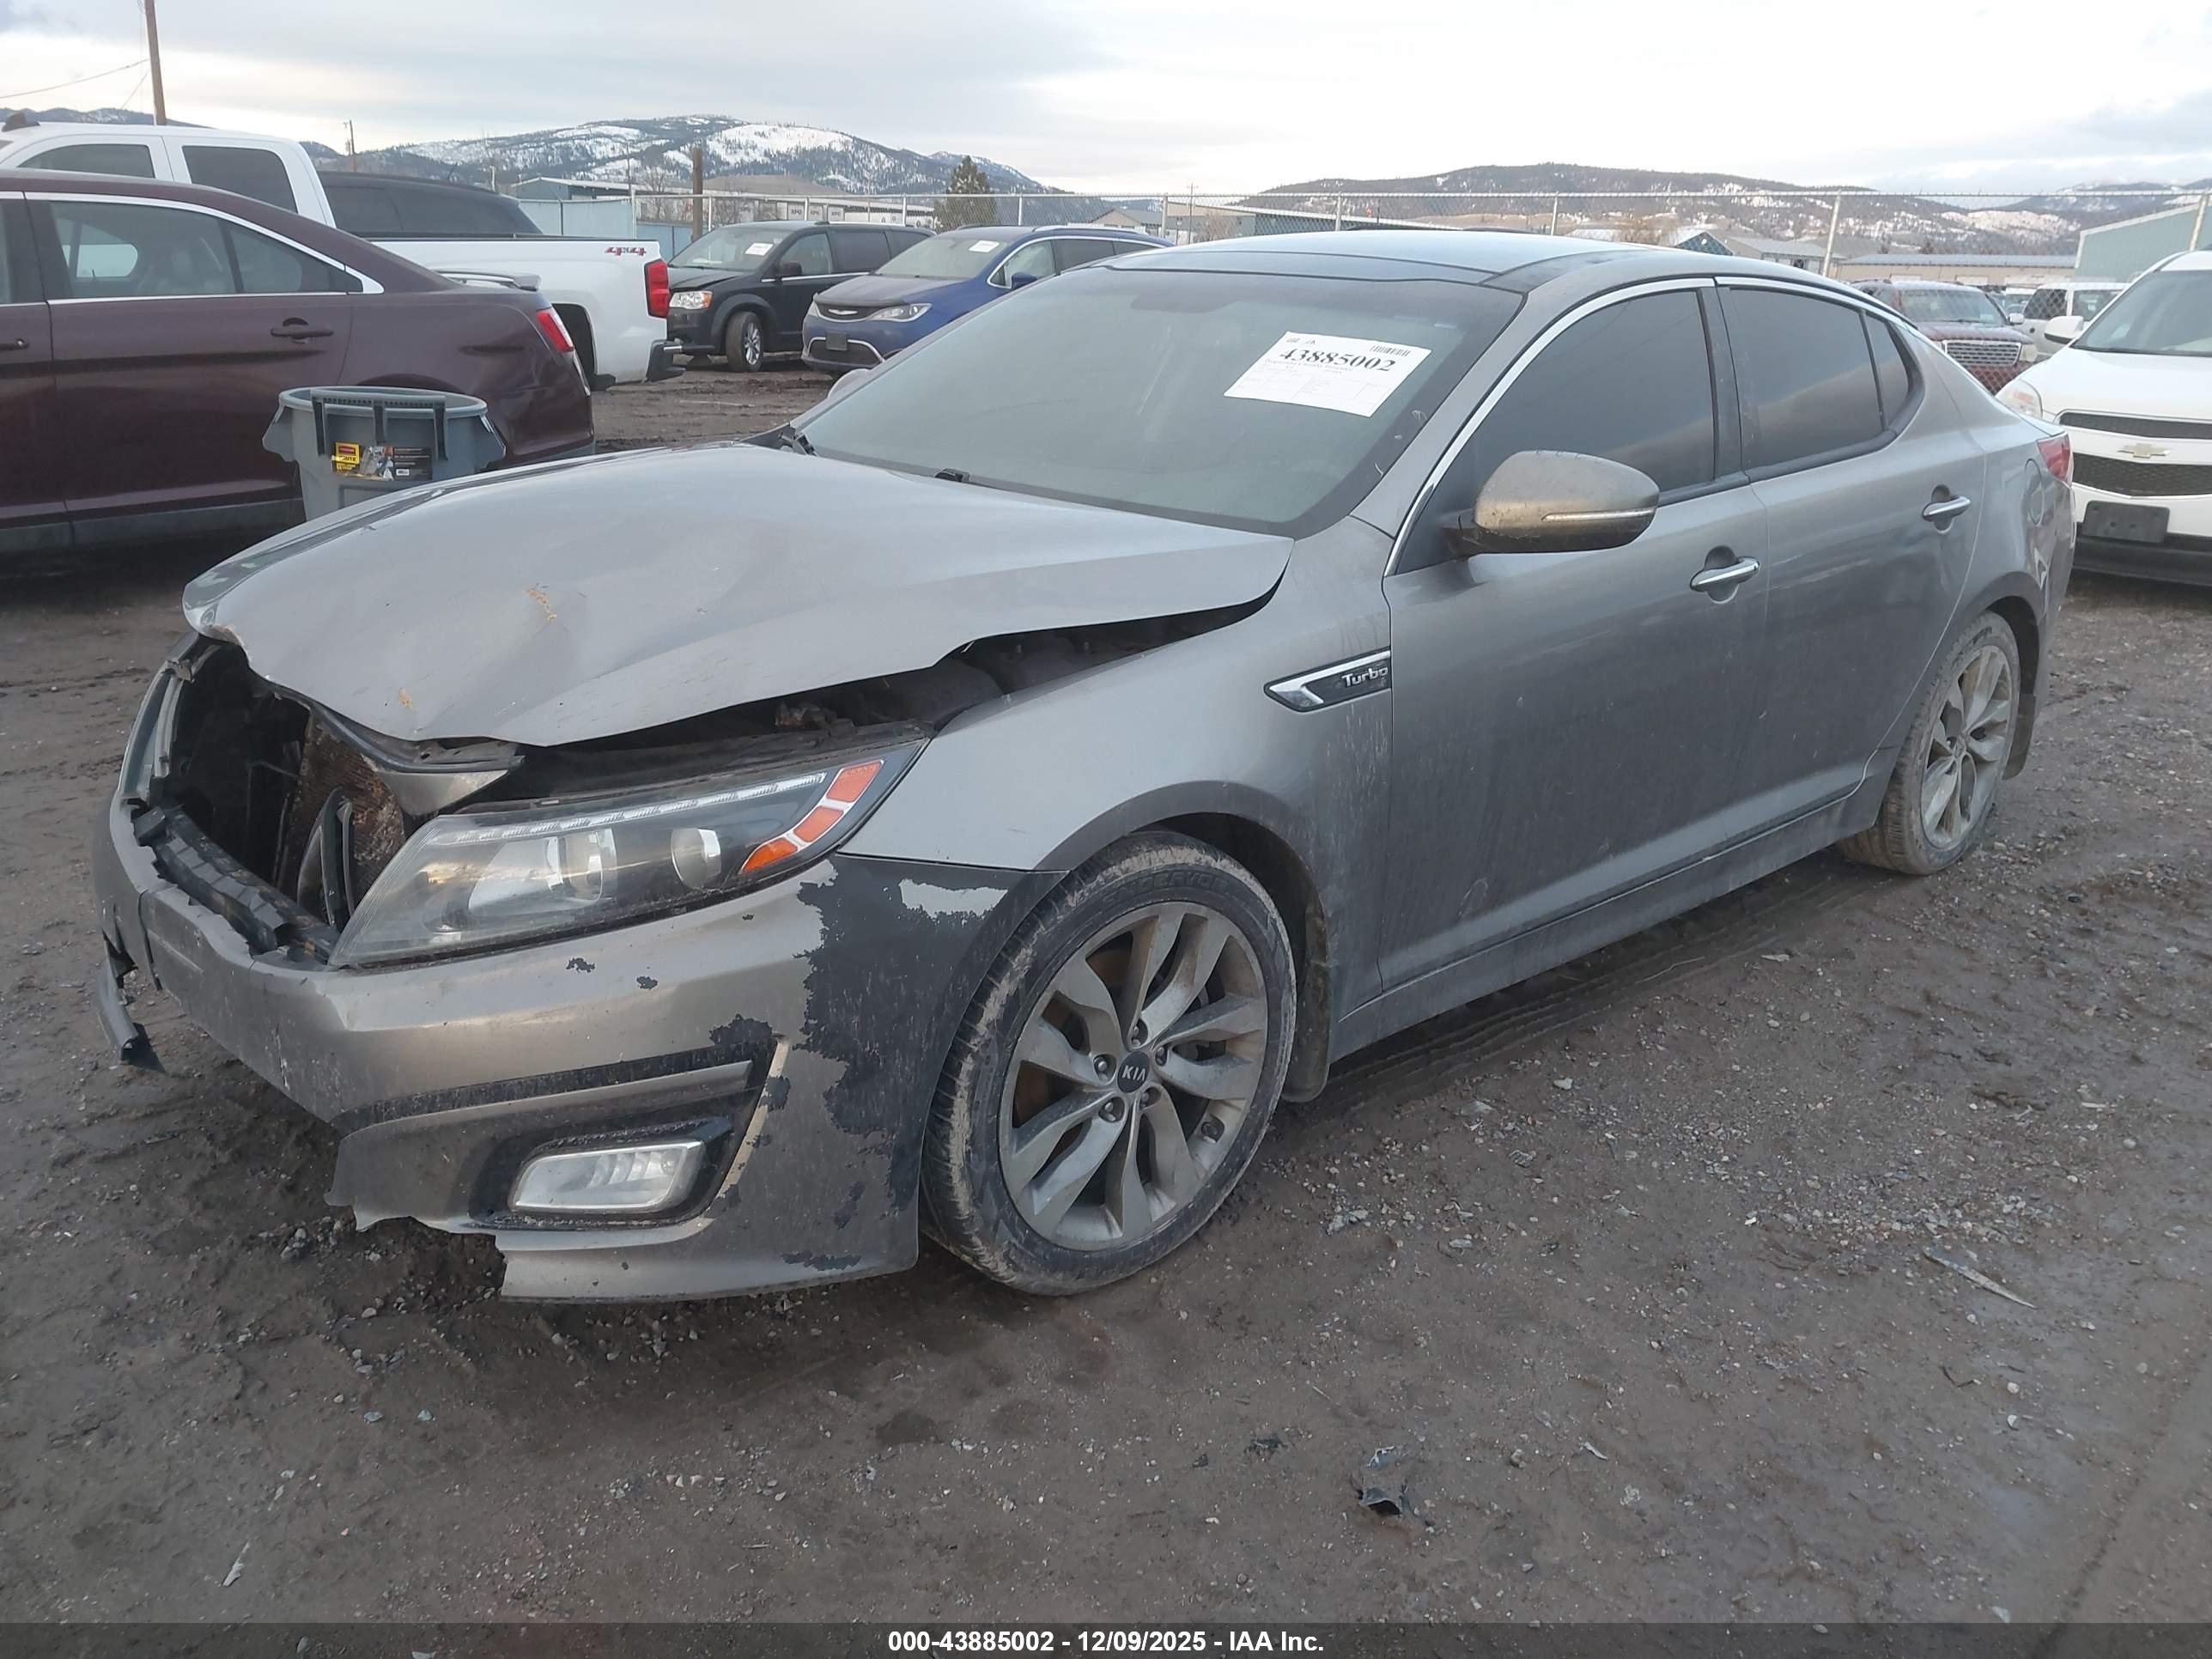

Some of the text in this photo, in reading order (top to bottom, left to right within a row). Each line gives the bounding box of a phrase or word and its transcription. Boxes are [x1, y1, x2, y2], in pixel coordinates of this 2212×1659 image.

[1279, 348, 1396, 372] 43885002
[1341, 666, 1389, 688] Turbo
[1121, 1065, 1146, 1081] KIA
